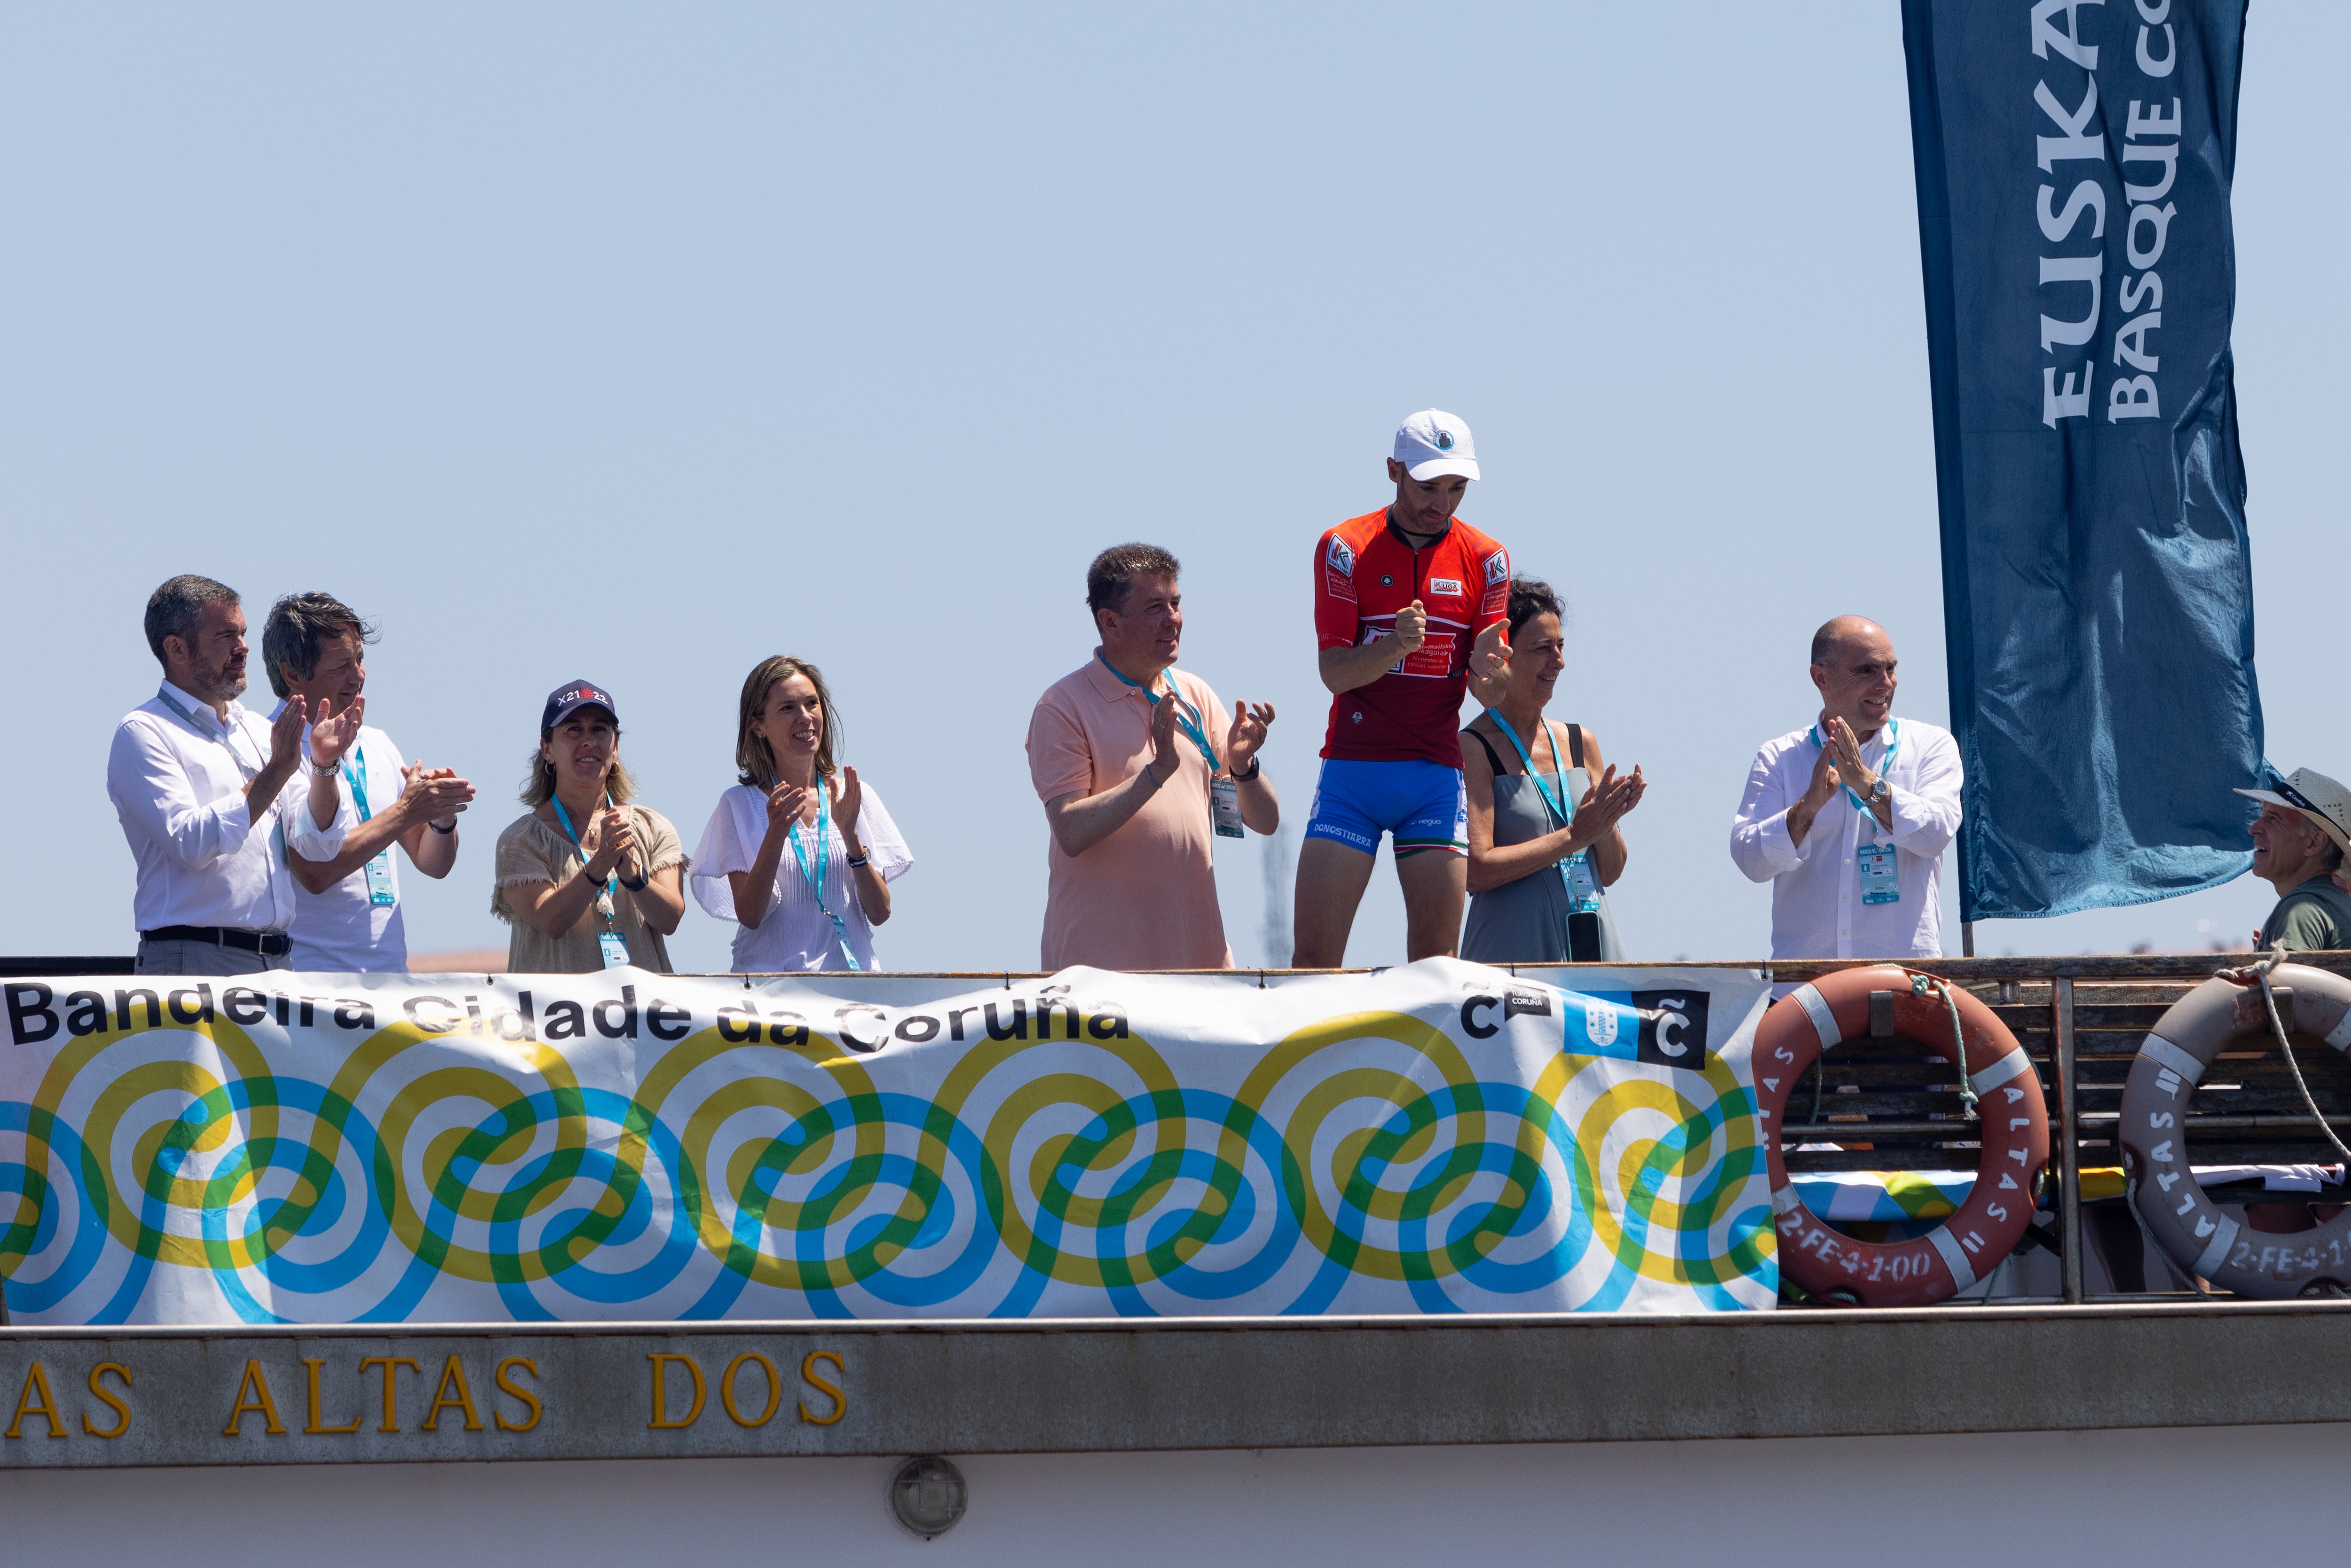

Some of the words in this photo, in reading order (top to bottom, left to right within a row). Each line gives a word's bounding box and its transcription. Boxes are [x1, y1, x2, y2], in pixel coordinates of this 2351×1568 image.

[2108, 97, 2182, 425] BASQUE
[558, 690, 580, 707] X21
[1314, 824, 1372, 847] DONOSTIARRA
[4, 982, 376, 1046] Bandeira
[402, 985, 691, 1042] Cidade
[717, 1000, 809, 1047] da
[834, 985, 1128, 1053] Coruña
[1512, 997, 1543, 1006] CORUÑA
[1987, 1087, 2030, 1223] ALTAS
[2149, 1111, 2217, 1238] ALTAS
[5, 1361, 132, 1439] AS
[223, 1355, 543, 1436] ALTAS
[647, 1350, 846, 1430] DOS
